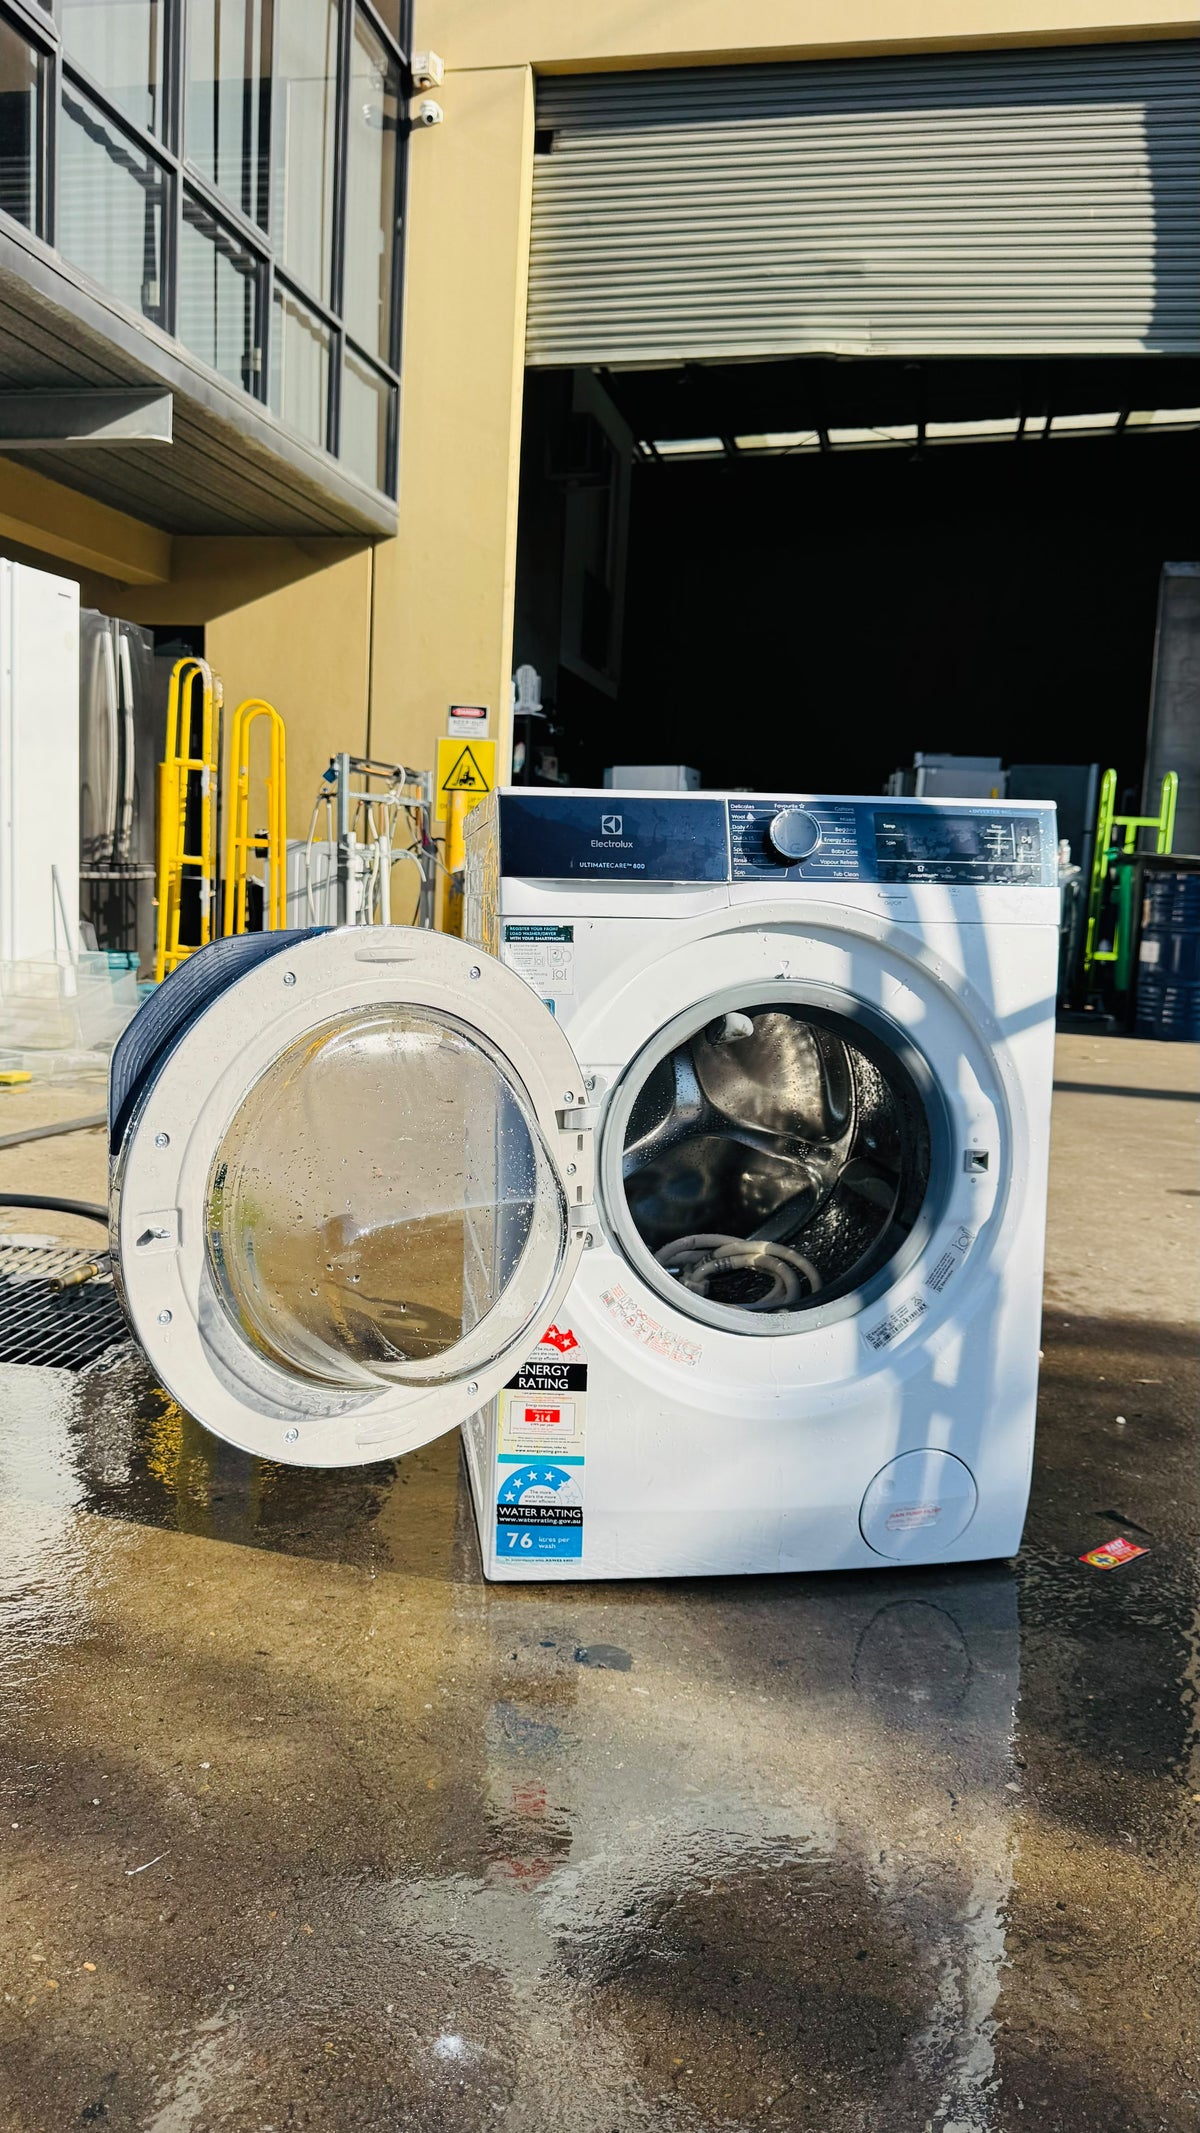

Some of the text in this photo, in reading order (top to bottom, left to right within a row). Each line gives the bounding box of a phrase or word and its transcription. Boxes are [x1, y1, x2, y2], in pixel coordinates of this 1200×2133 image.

[590, 839, 633, 849] Electrolux
[518, 1364, 570, 1376] ENERGY
[518, 1377, 569, 1389] RATING
[534, 1414, 551, 1423] 214
[499, 1507, 581, 1518] WATER RATING
[506, 1532, 533, 1549] 76
